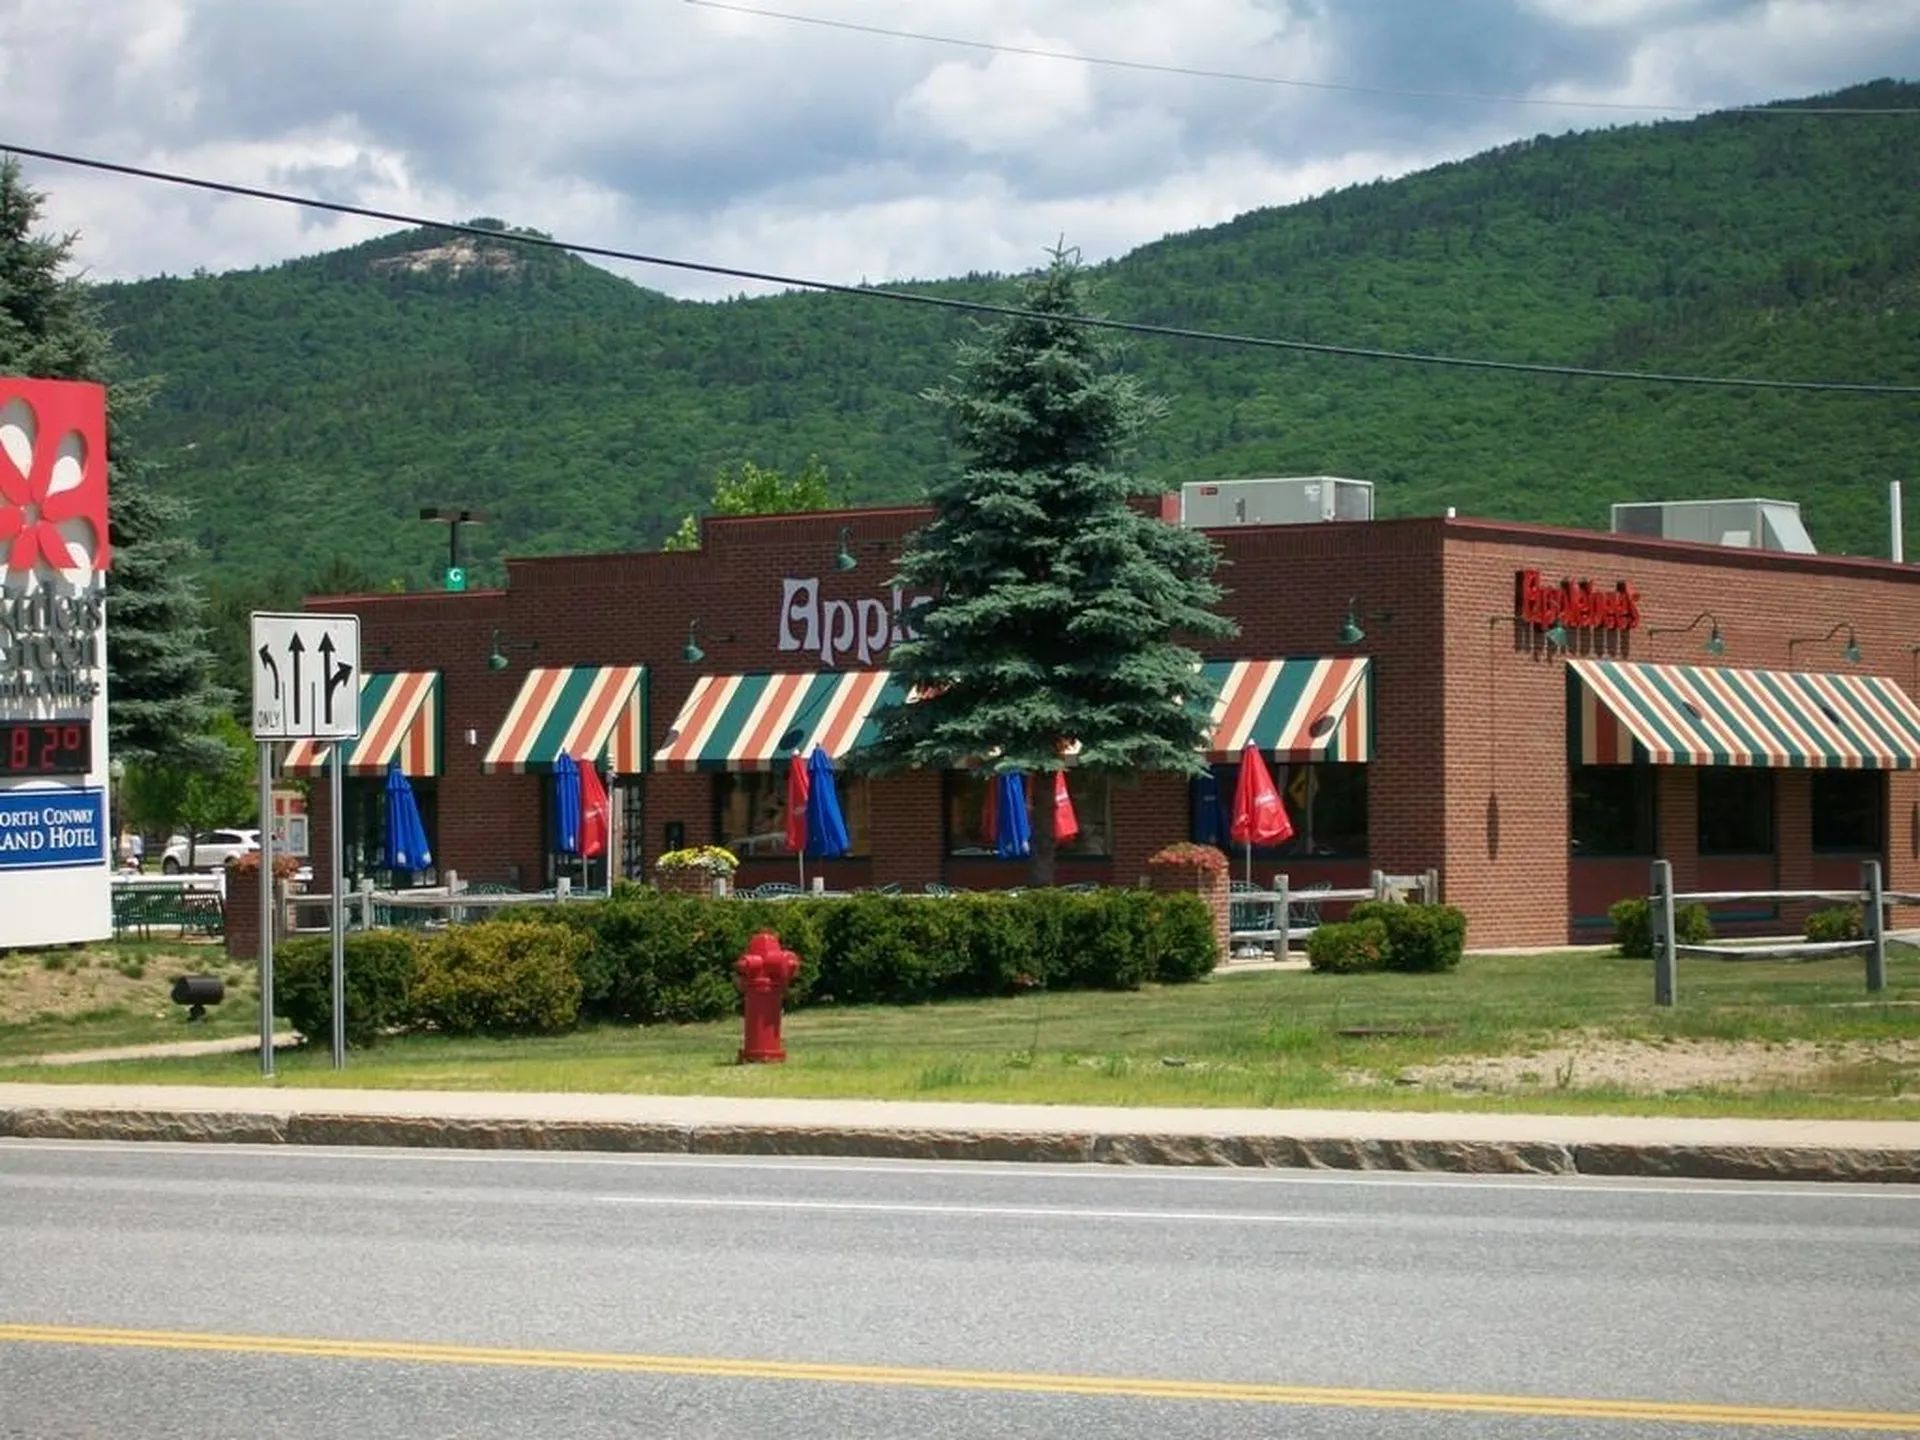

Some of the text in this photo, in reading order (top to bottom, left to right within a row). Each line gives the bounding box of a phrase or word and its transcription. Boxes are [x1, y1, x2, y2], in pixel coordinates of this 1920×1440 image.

[257, 709, 281, 729] ONLY
[43, 807, 94, 825] CONWAY
[49, 826, 98, 848] HOTEL
